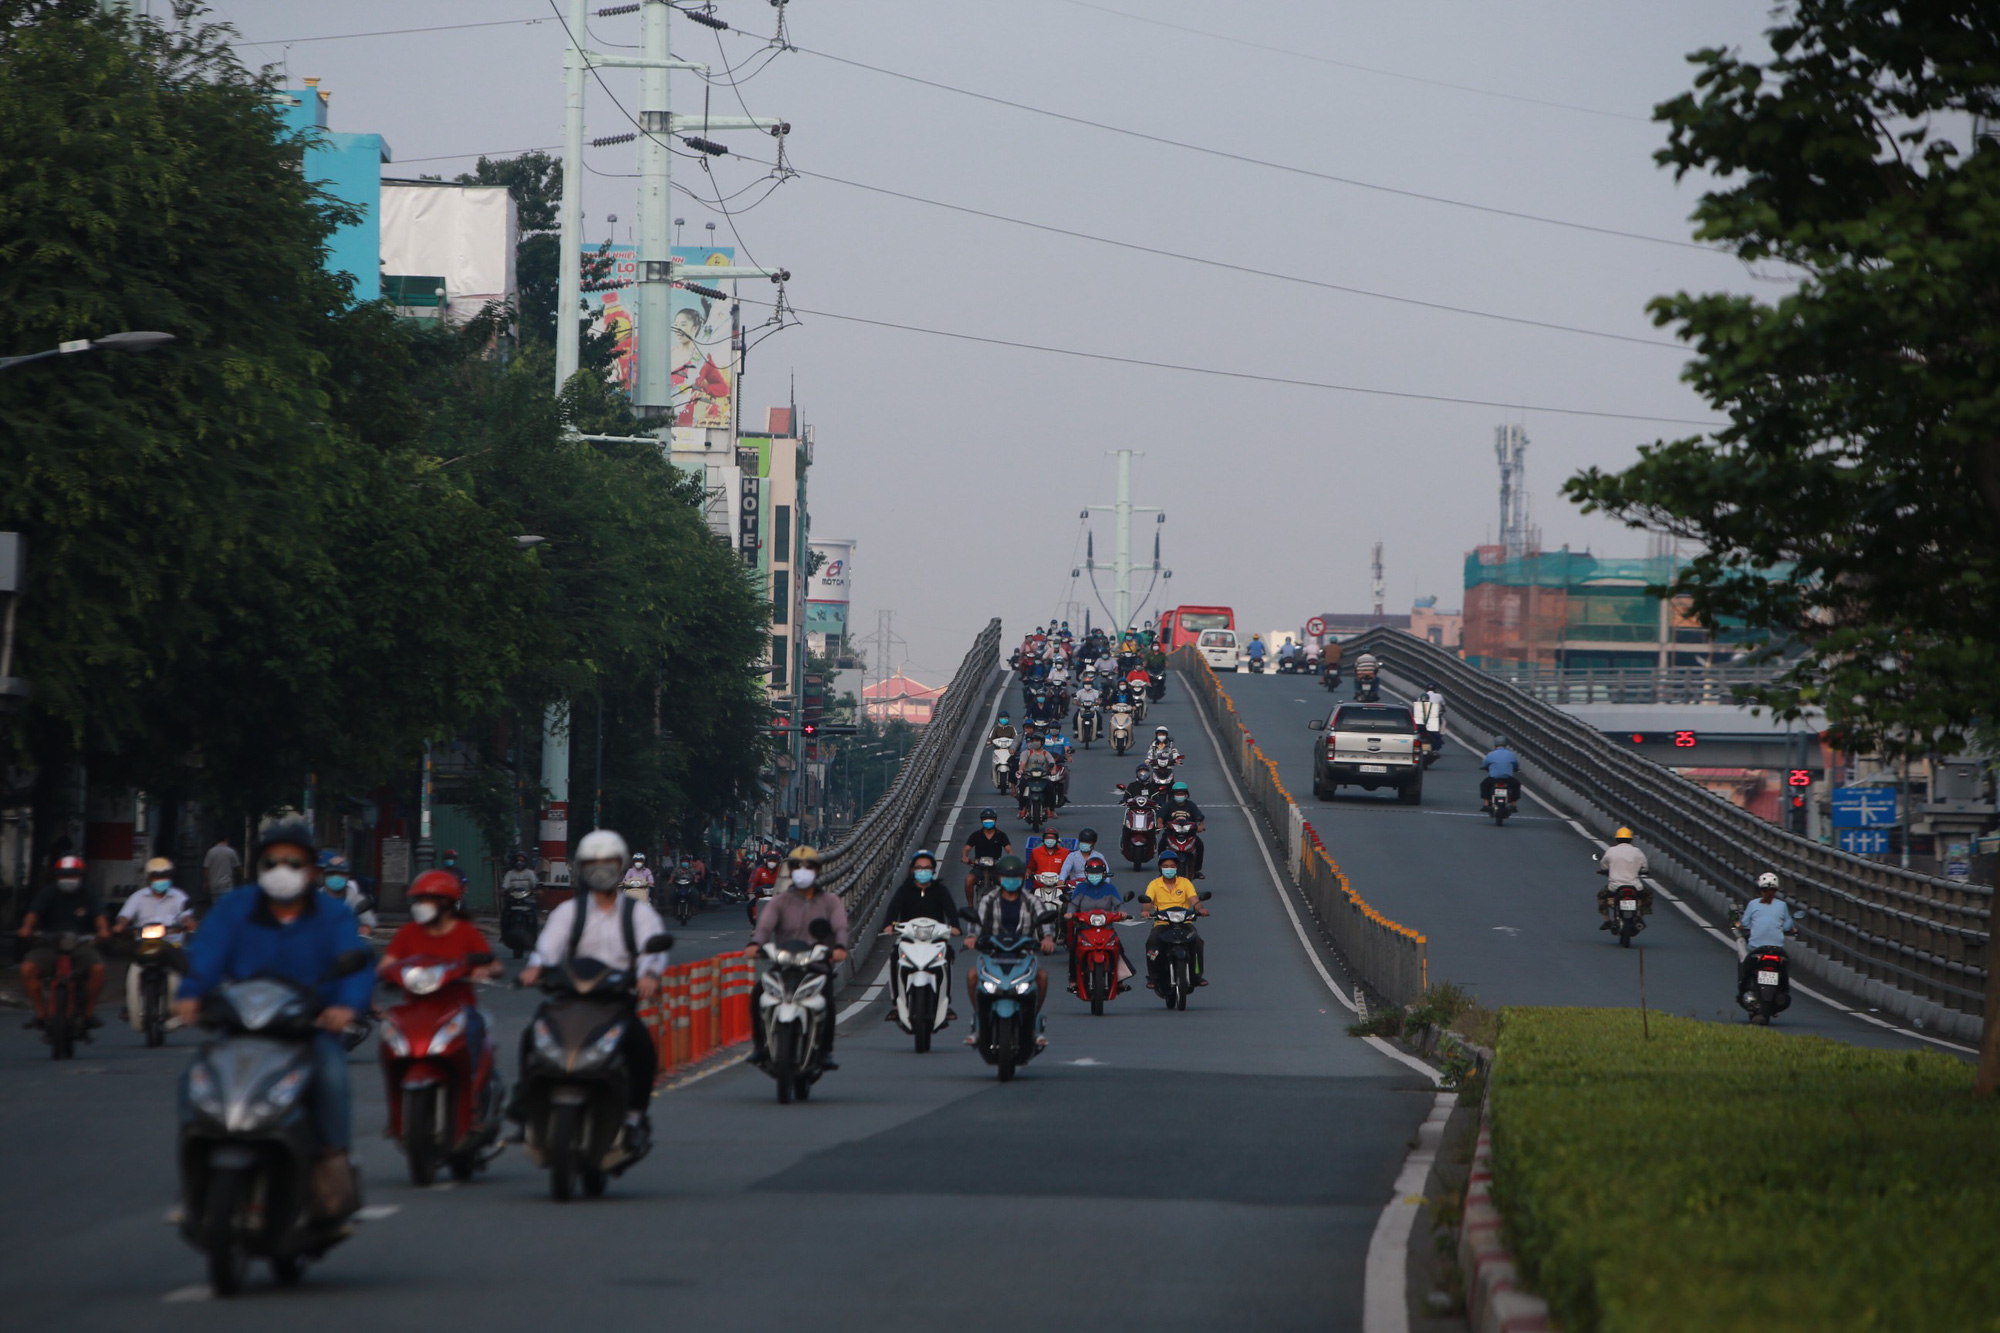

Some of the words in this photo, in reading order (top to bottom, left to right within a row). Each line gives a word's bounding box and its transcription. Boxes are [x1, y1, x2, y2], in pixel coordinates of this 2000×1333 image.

[743, 480, 757, 568] HOTEL
[1675, 731, 1696, 747] 25
[1789, 769, 1810, 786] 25
